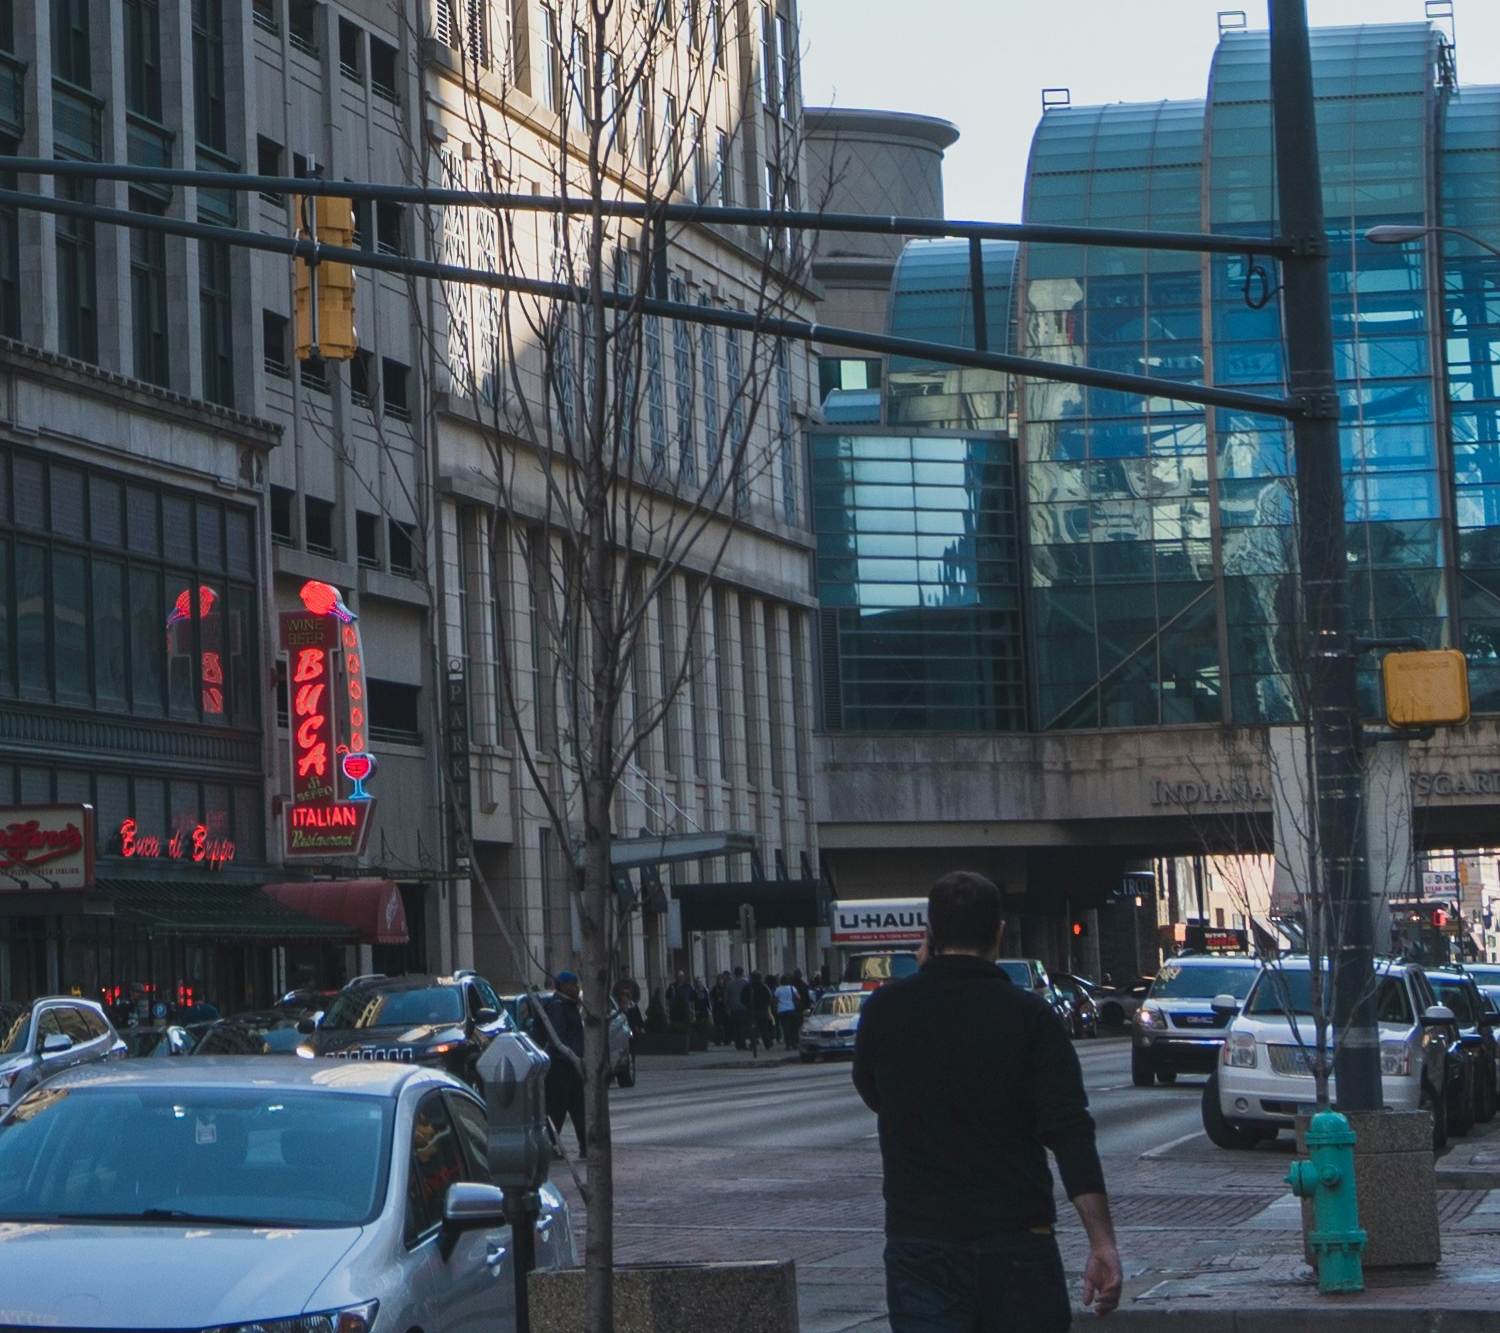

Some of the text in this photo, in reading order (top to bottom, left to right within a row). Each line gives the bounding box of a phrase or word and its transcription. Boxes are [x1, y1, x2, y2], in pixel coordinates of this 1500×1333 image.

[287, 618, 324, 631] WINE
[288, 633, 324, 645] BEER
[293, 647, 326, 777] BUCA
[297, 786, 333, 802] BEPPO
[293, 807, 357, 827] ITALIAN
[121, 818, 159, 857] Buca
[191, 823, 236, 871] Beppo
[292, 830, 355, 848] Restaurant
[840, 912, 928, 929] U-HAUL
